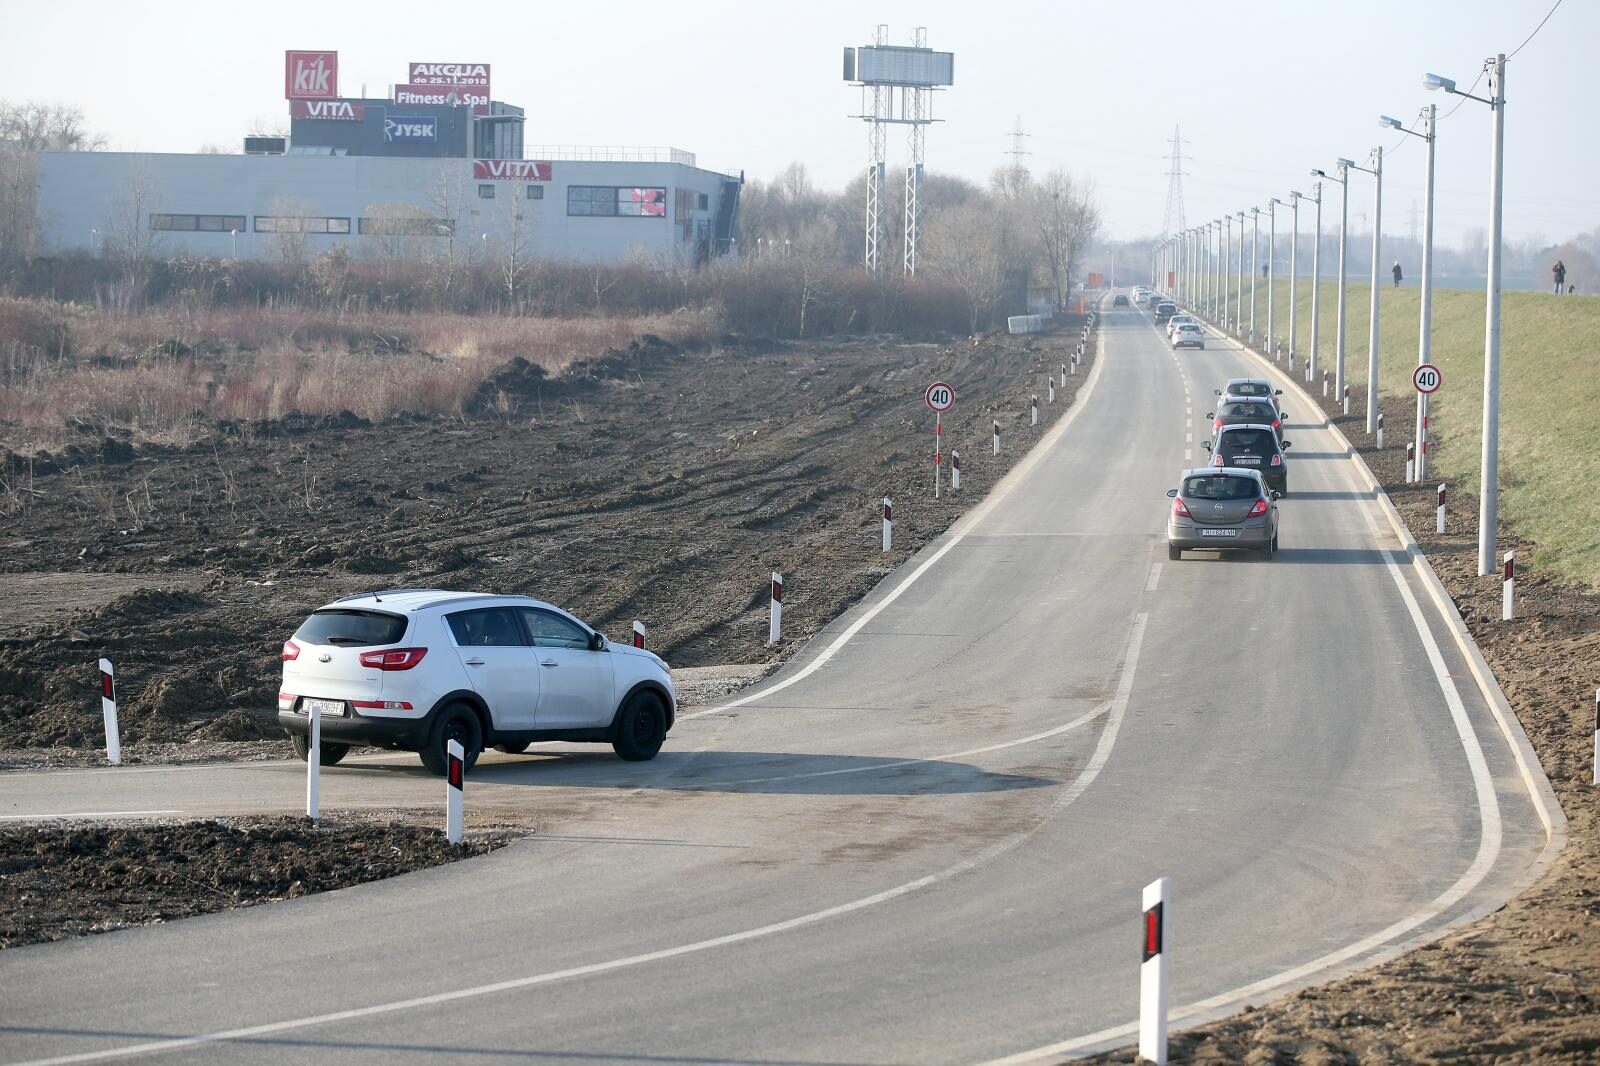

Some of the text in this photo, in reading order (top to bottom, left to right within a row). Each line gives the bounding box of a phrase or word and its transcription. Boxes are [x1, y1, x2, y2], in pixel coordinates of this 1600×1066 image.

[413, 64, 487, 77] AKCIJA
[398, 92, 444, 105] Fitness
[463, 93, 488, 108] Spa
[306, 101, 355, 117] VITA
[394, 124, 434, 137] JYSK
[488, 161, 540, 177] VITA
[1419, 372, 1435, 386] 40
[932, 390, 948, 404] 40
